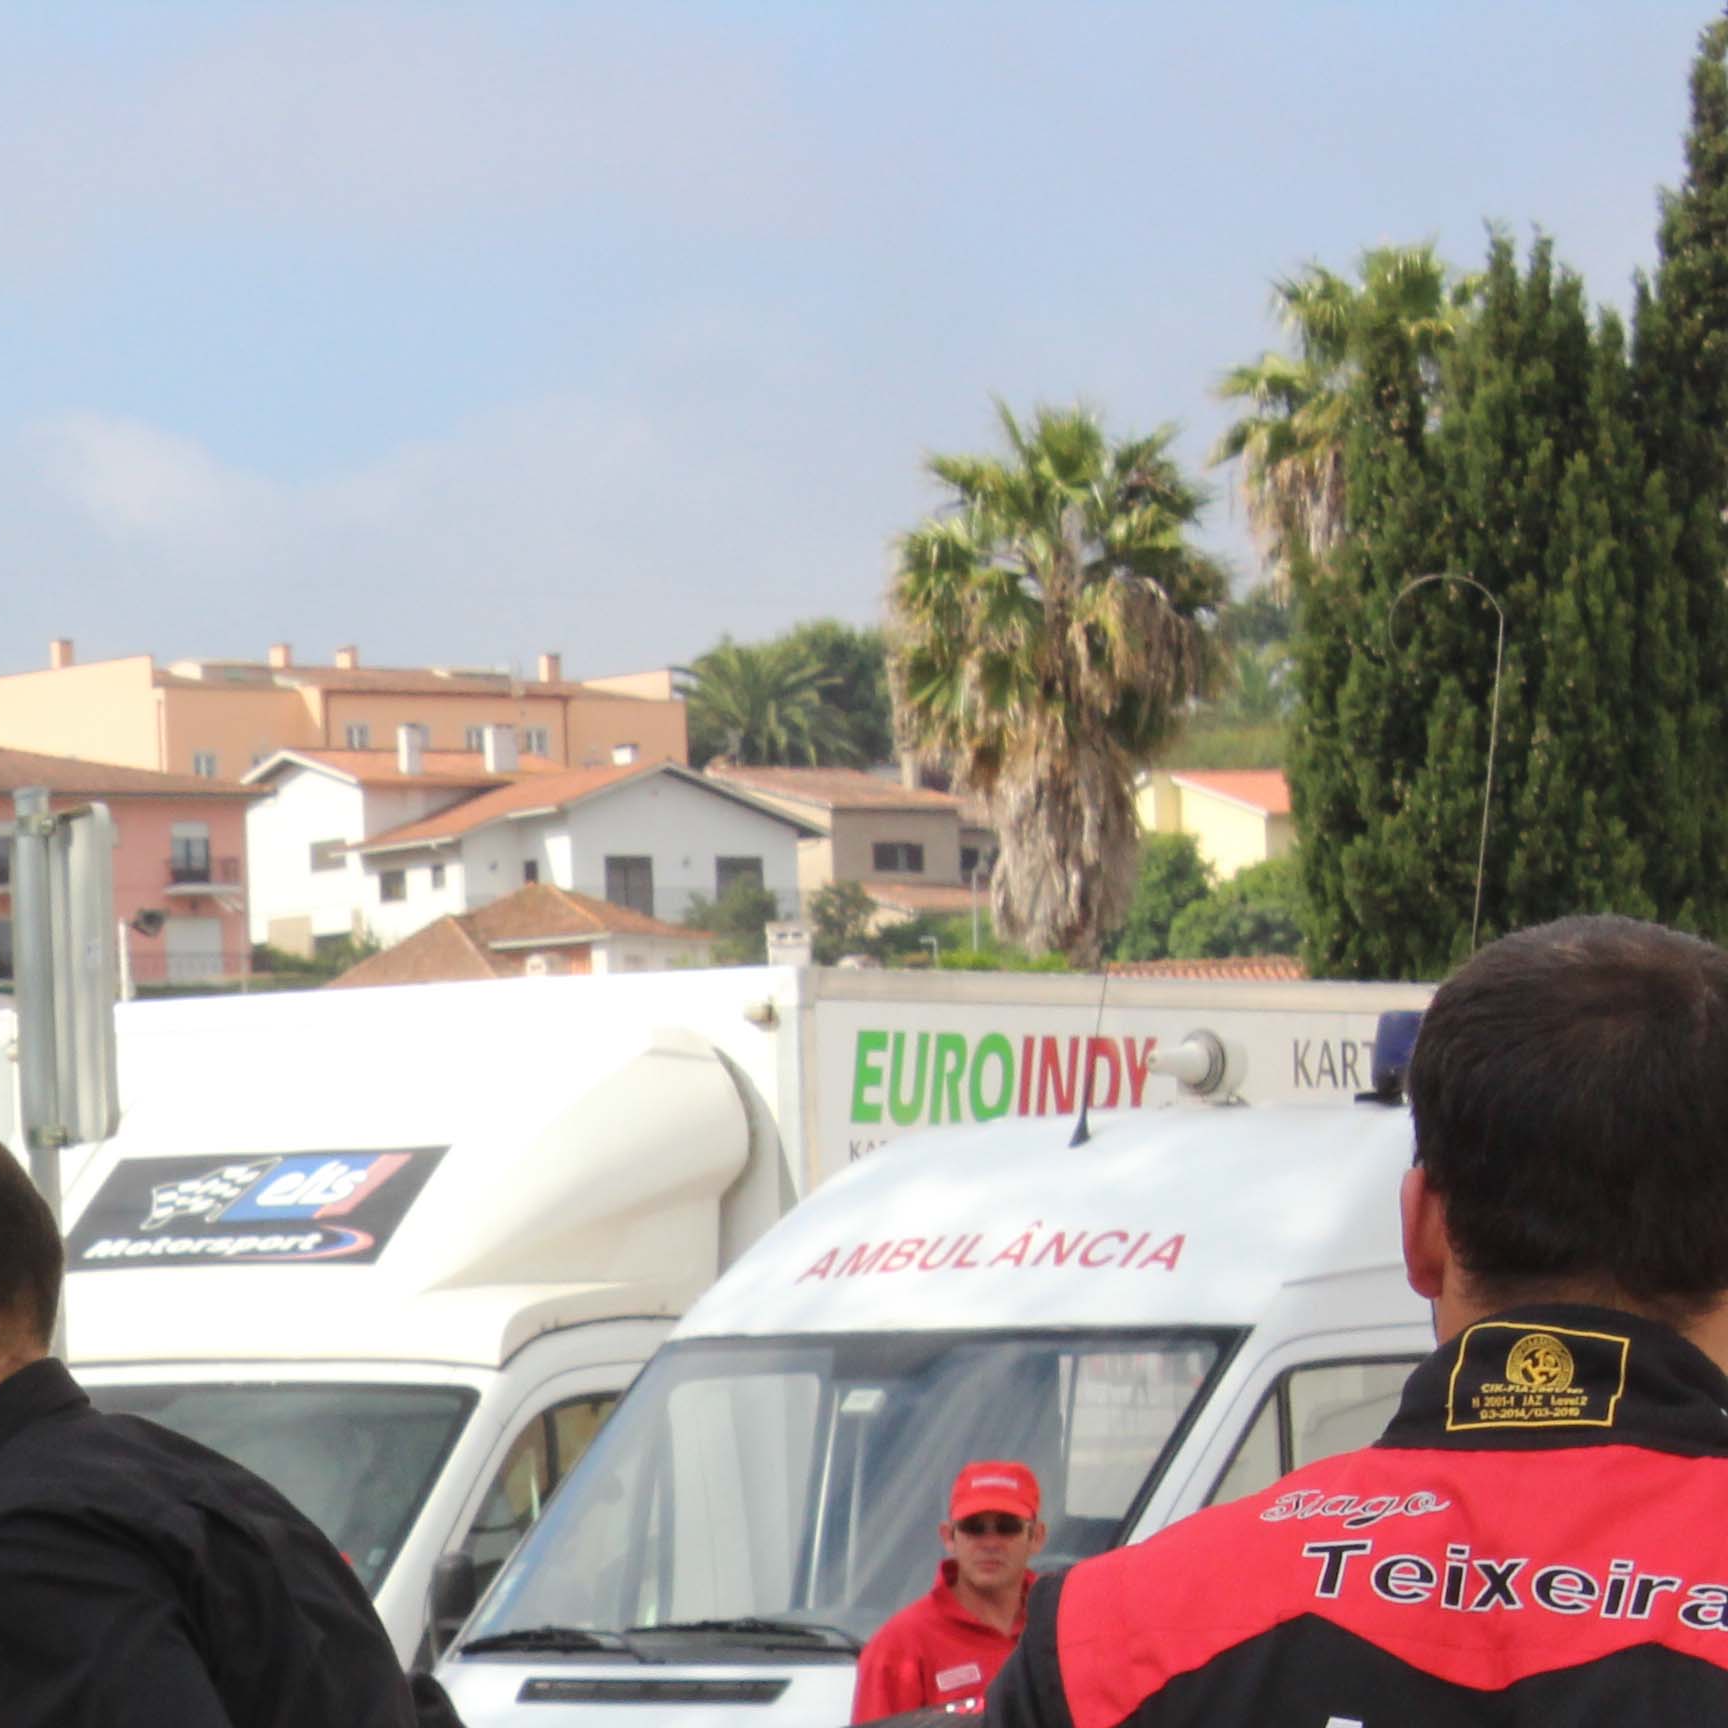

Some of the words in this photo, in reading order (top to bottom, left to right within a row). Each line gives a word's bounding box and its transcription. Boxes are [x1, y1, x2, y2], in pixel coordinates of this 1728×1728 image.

[849, 1030, 1157, 1126] EUROINDY
[84, 1231, 324, 1260] Motorsport
[795, 1219, 1187, 1287] AMBULÂNCIA
[1260, 1487, 1450, 1529] Tiago
